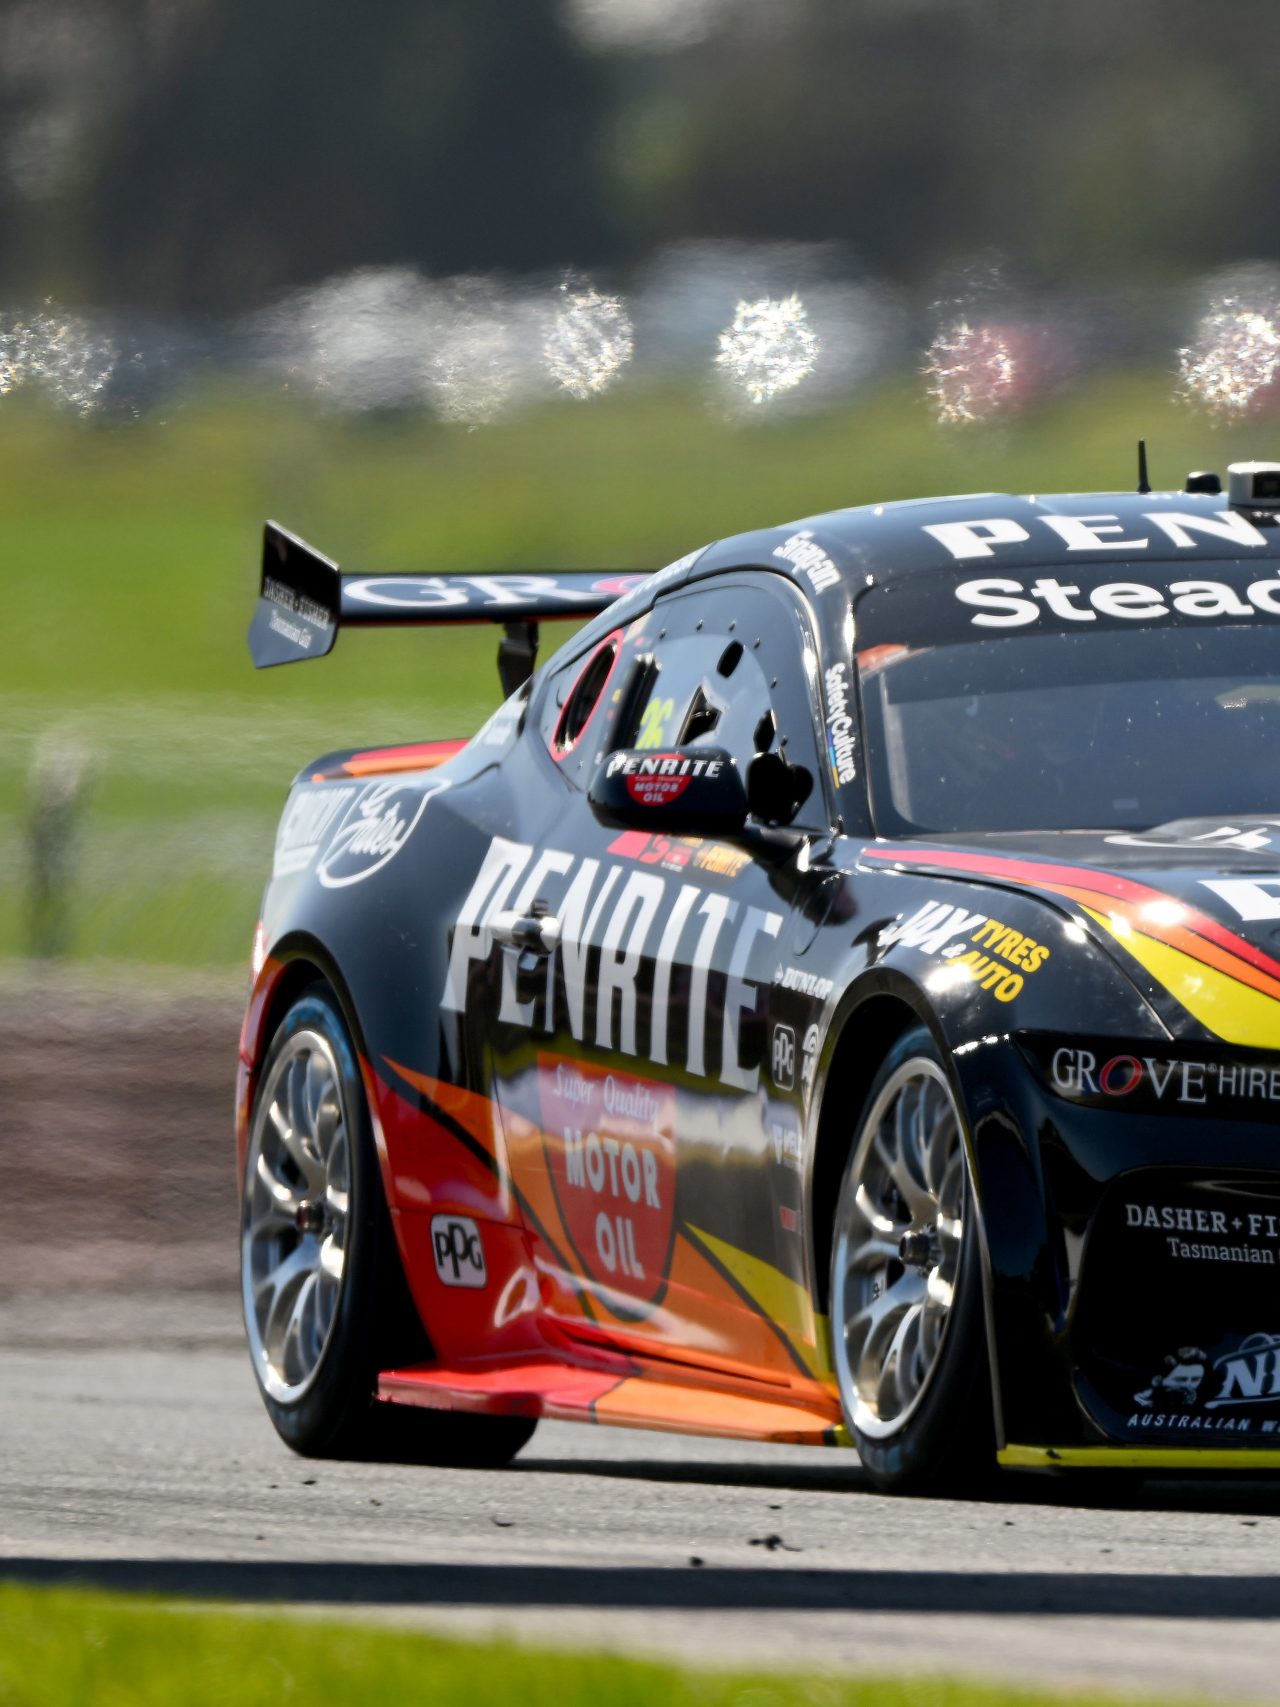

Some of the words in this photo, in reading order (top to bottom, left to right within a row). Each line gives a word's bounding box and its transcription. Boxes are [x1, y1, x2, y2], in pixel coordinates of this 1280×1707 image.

[824, 662, 857, 785] SafetyCulture
[606, 758, 724, 778] PENRITE
[634, 782, 680, 793] MOTOR
[643, 793, 665, 802] OIL
[439, 836, 784, 1093] PENRITE
[970, 918, 1051, 973] TYRES
[782, 967, 834, 1000] DUNLOP
[945, 950, 1024, 1003] AUTO
[564, 1127, 661, 1209] MOTOR
[1125, 1204, 1227, 1235] DASHER
[433, 1222, 483, 1279] PPG
[595, 1211, 646, 1281] OIL
[1166, 1237, 1275, 1265] Tasmanian
[1127, 1413, 1249, 1431] AUSTRALIAN
